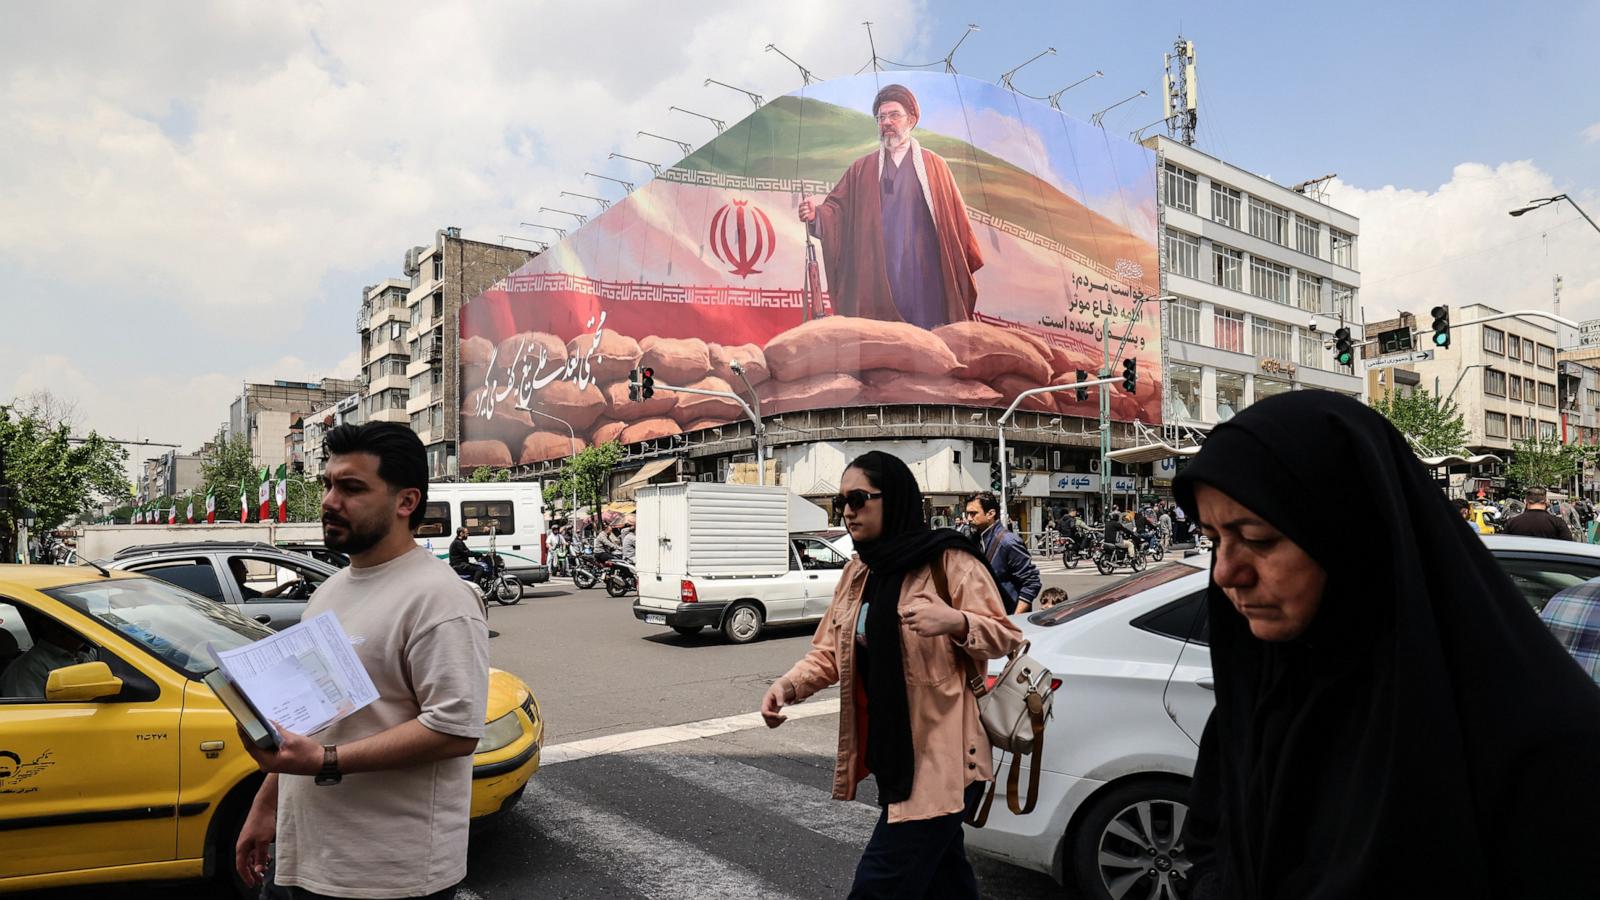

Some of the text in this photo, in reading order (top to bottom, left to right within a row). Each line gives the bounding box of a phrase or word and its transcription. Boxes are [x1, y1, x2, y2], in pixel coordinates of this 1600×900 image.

[1110, 284, 1144, 304] خواست
[1093, 299, 1118, 318] دفاع
[1070, 320, 1095, 335] کننده
[1057, 475, 1090, 489] کوه نور
